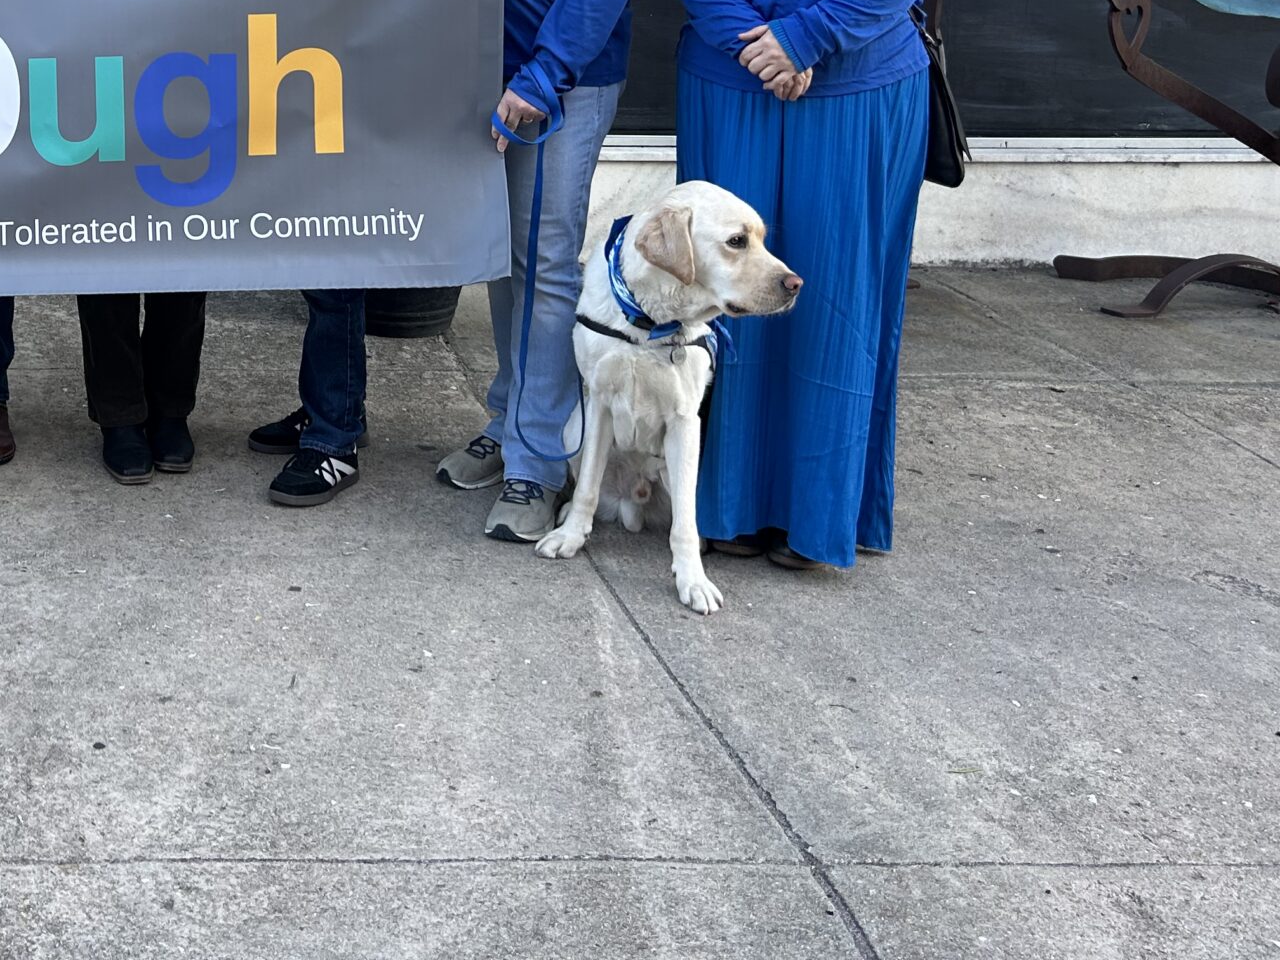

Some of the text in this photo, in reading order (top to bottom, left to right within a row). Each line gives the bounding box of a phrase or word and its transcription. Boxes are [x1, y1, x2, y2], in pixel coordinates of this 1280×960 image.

[147, 214, 172, 242] in
[183, 214, 240, 241] Our
[250, 207, 425, 241] Community
